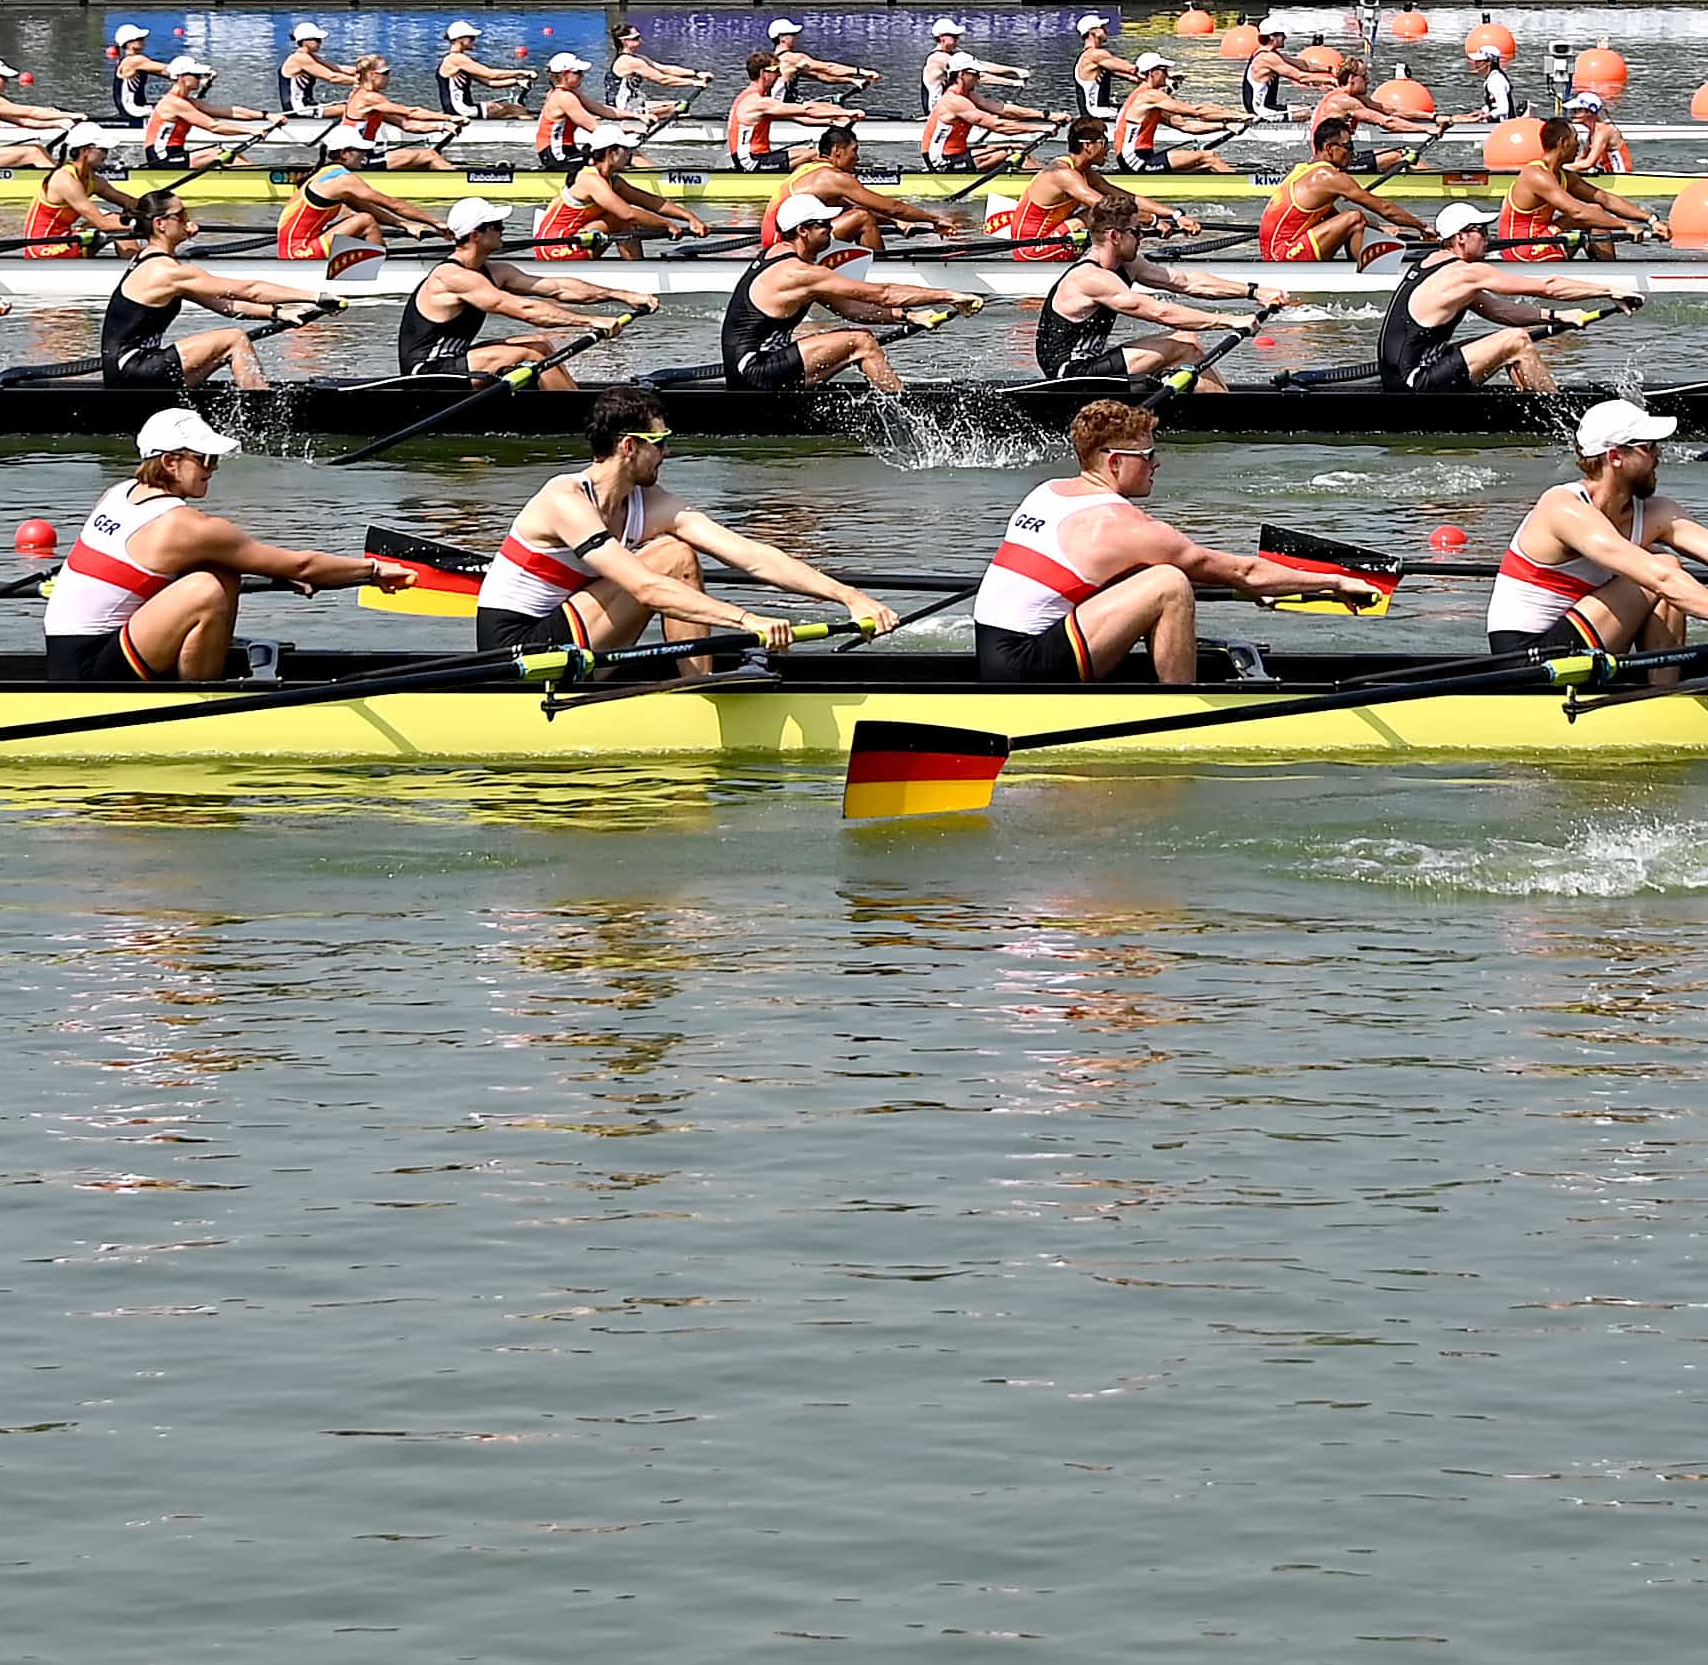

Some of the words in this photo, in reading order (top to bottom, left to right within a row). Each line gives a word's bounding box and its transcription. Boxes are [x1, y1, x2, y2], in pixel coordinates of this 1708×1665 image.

[668, 173, 702, 185] kiwa
[93, 513, 122, 536] GER
[1014, 513, 1046, 534] GER
